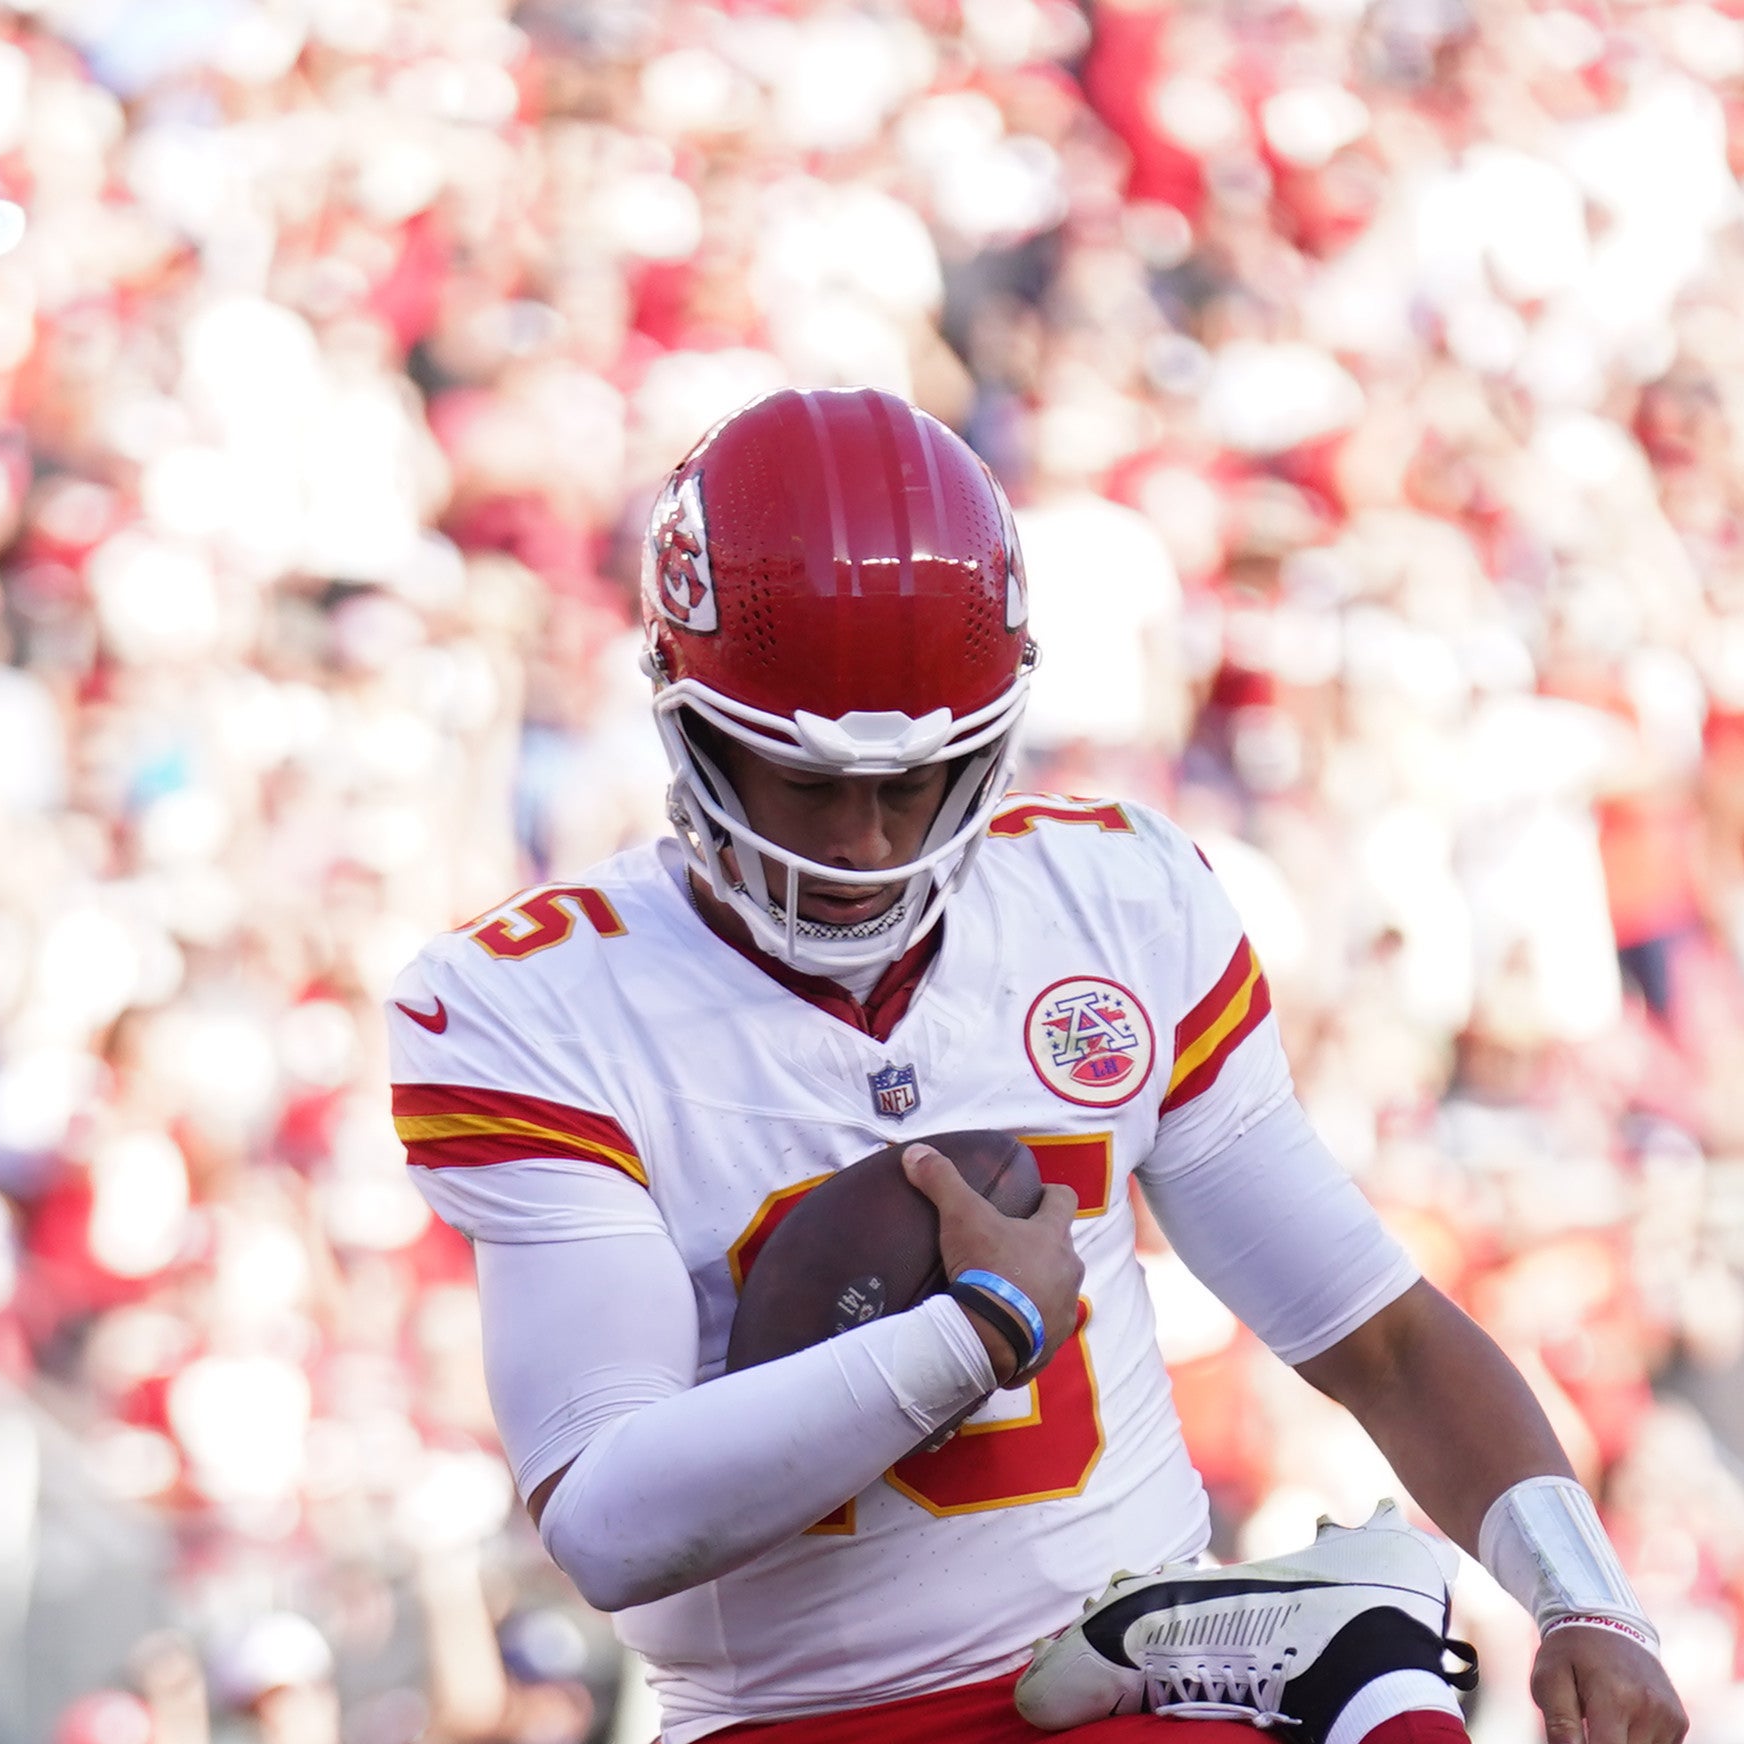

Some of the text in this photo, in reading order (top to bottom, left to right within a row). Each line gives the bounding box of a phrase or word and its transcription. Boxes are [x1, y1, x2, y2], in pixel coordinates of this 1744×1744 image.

[454, 882, 629, 961] 5
[1053, 992, 1138, 1066] A
[880, 1087, 914, 1112] NFL
[1584, 1615, 1646, 1643] COURAGE
